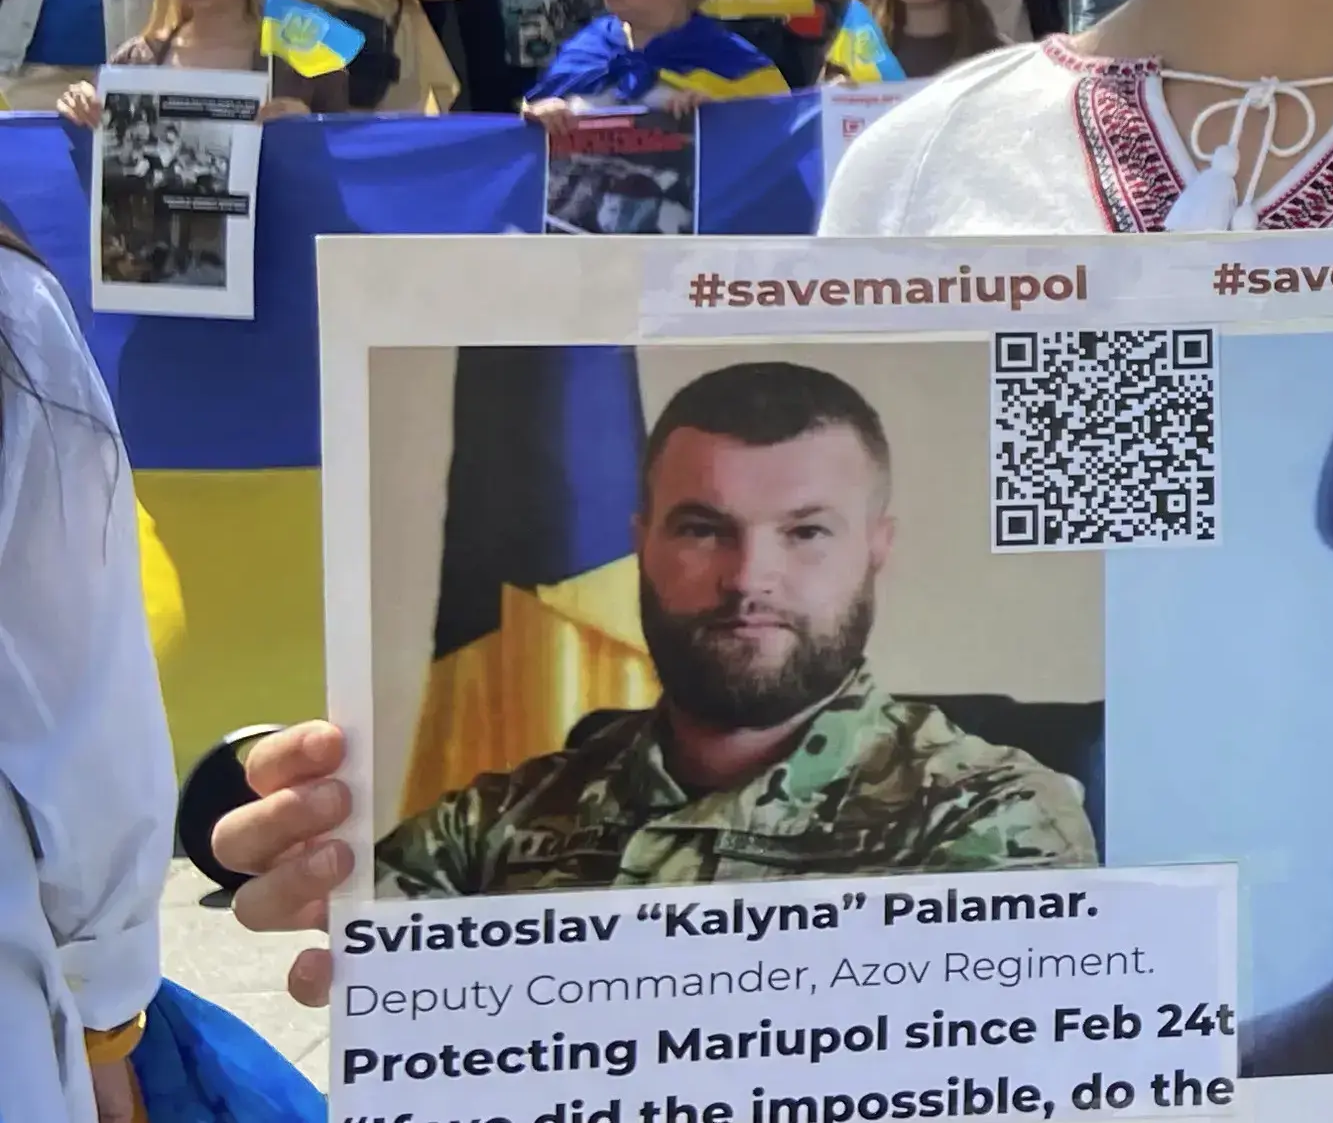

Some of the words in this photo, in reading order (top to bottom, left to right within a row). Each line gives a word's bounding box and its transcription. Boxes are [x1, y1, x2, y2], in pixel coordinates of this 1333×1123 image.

[688, 264, 1087, 311] #savemariupol
[344, 908, 620, 955] Sviatoslav
[636, 892, 867, 941] “Kalyna”
[884, 888, 1098, 925] Palamar.
[346, 981, 513, 1020] Deputy
[526, 961, 817, 1005] Commander,
[829, 958, 931, 988] Azov
[945, 947, 1155, 987] Regiment.
[343, 1031, 637, 1084] Protecting
[658, 1015, 888, 1063] Mariupol
[905, 1009, 1037, 1049] since
[1054, 1004, 1143, 1042] Feb
[1157, 1002, 1235, 1039] 24t
[533, 1098, 621, 1123] did
[640, 1095, 734, 1123] the
[752, 1076, 1055, 1123] impossible,
[1071, 1072, 1136, 1111] do
[1150, 1069, 1235, 1108] the
